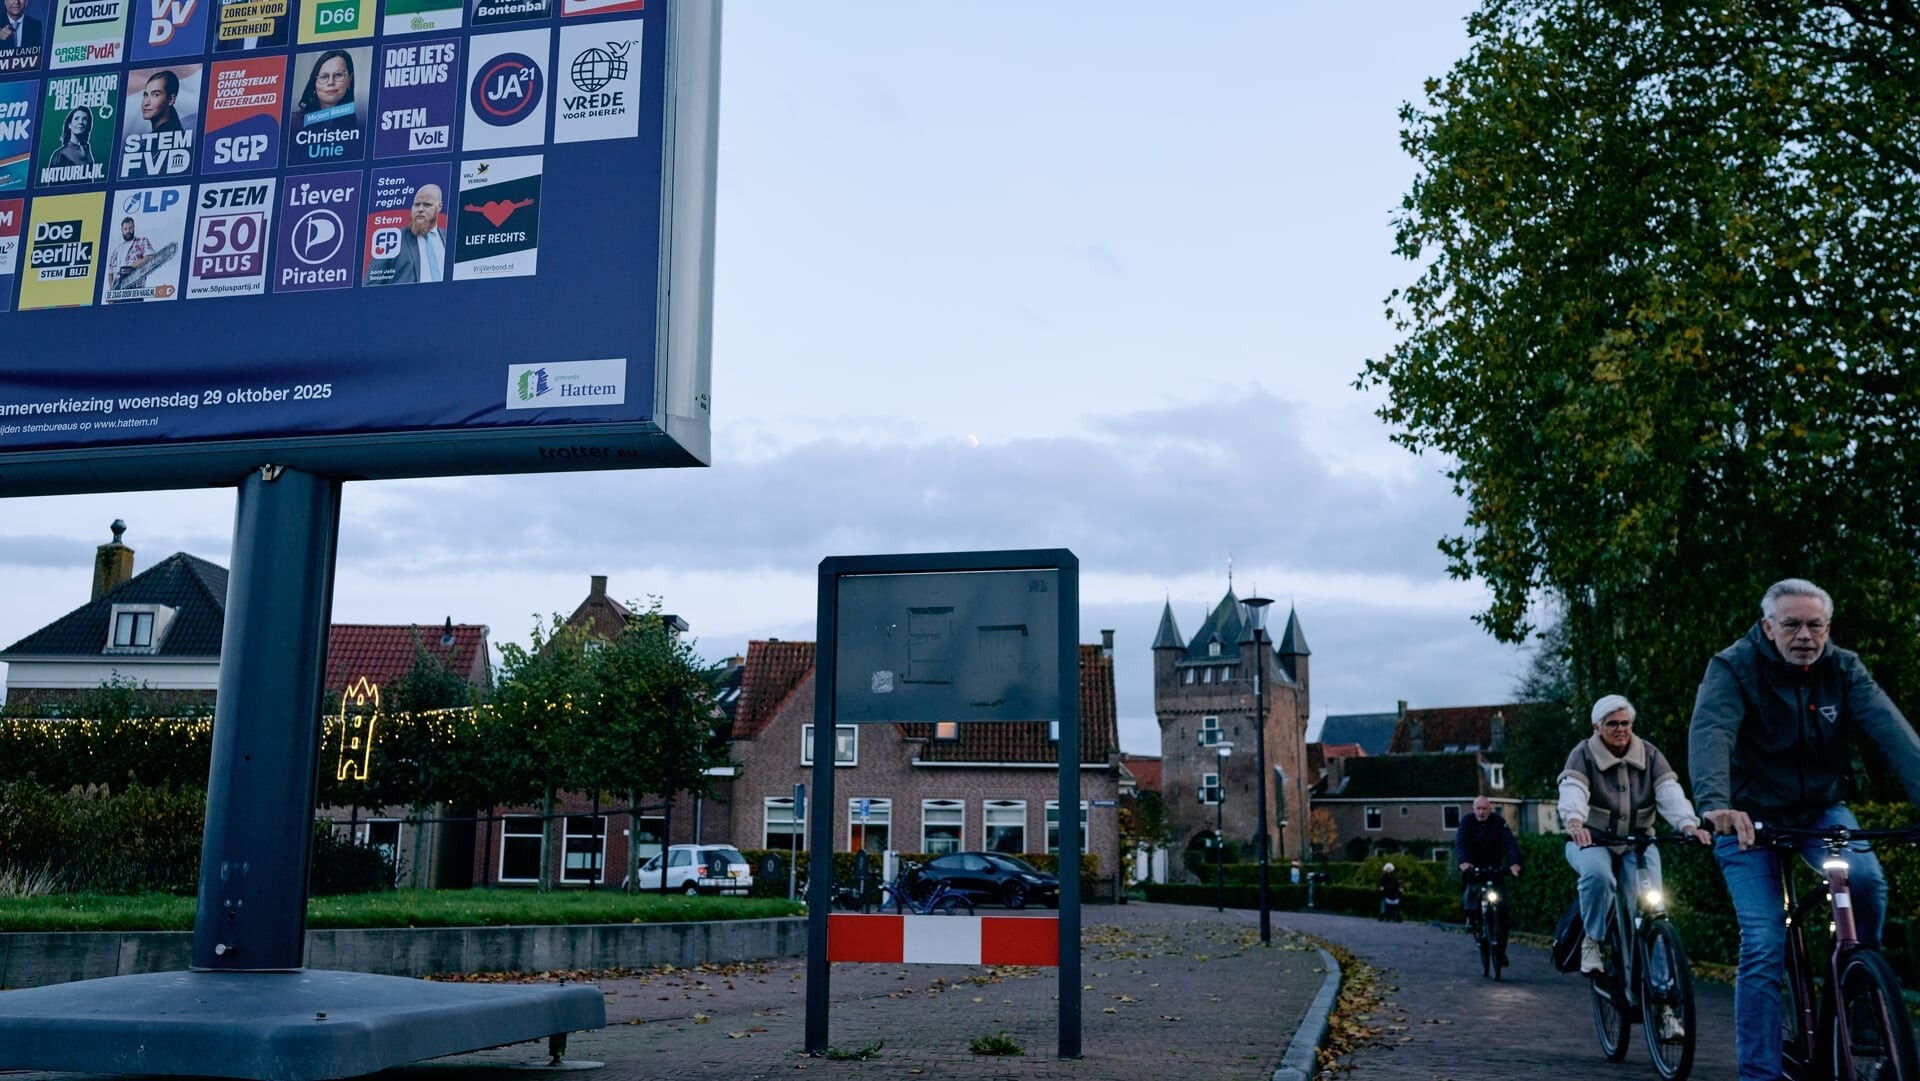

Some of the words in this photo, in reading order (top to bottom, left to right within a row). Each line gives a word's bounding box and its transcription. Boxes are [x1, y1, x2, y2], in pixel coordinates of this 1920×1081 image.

[69, 3, 120, 19] VOORUIT
[224, 5, 257, 18] ZORGEN
[260, 3, 284, 15] VOOR
[319, 7, 355, 26] D66
[478, 0, 546, 17] Bontenbal
[222, 23, 272, 37] ZEKERHEID!
[15, 46, 41, 56] LAND!
[55, 46, 87, 56] GROEN
[59, 53, 86, 63] LINKS
[386, 48, 416, 68] DOE
[419, 43, 456, 65] IETS
[12, 56, 38, 69] PVV
[217, 75, 278, 89] CHRISTELIJK
[218, 69, 246, 80] STEM
[384, 63, 449, 88] NIEUWS
[48, 76, 87, 96] PARTIJ
[89, 74, 118, 93] VOOR
[217, 87, 244, 98] VOOR
[54, 94, 69, 110] DE
[70, 90, 108, 109] DIEREN
[215, 94, 275, 108] NEDERLAND
[562, 91, 624, 111] VREDE
[381, 107, 427, 131] STEM
[562, 111, 586, 120] VOOR
[588, 107, 625, 117] DIEREN
[124, 129, 193, 153] STEM
[295, 128, 360, 145] Christen
[414, 130, 444, 146] Volt
[214, 134, 268, 164] SGP
[308, 143, 344, 159] Unie
[121, 149, 190, 177] FVD
[40, 163, 105, 183] NATUURLIJK.
[377, 177, 405, 186] Stem
[201, 185, 268, 209] STEM
[290, 183, 354, 206] Liever
[376, 188, 399, 196] voor
[401, 186, 415, 195] de
[142, 189, 179, 213] LP
[375, 197, 405, 208] regio!
[374, 216, 402, 225] Stem
[35, 223, 73, 240] Doe
[202, 216, 256, 254] 50
[465, 234, 487, 245] LIEF
[31, 242, 92, 266] eerlijk.
[69, 266, 87, 276] BIJ1
[201, 255, 251, 274] PLUS
[472, 263, 514, 273] VrijVerbond.nl
[41, 269, 63, 278] STEM
[282, 267, 347, 285] Piraten
[191, 282, 260, 294] www.50pluspartij.nl
[560, 384, 616, 397] Hattem
[0, 397, 113, 416] amerverkiezing
[118, 391, 199, 410] woensdag
[203, 390, 222, 405] 29
[226, 387, 290, 404] oktober
[293, 383, 332, 400] 2025
[22, 422, 78, 433] stembureaus
[80, 422, 91, 431] op
[94, 417, 159, 429] www.hattem.nl
